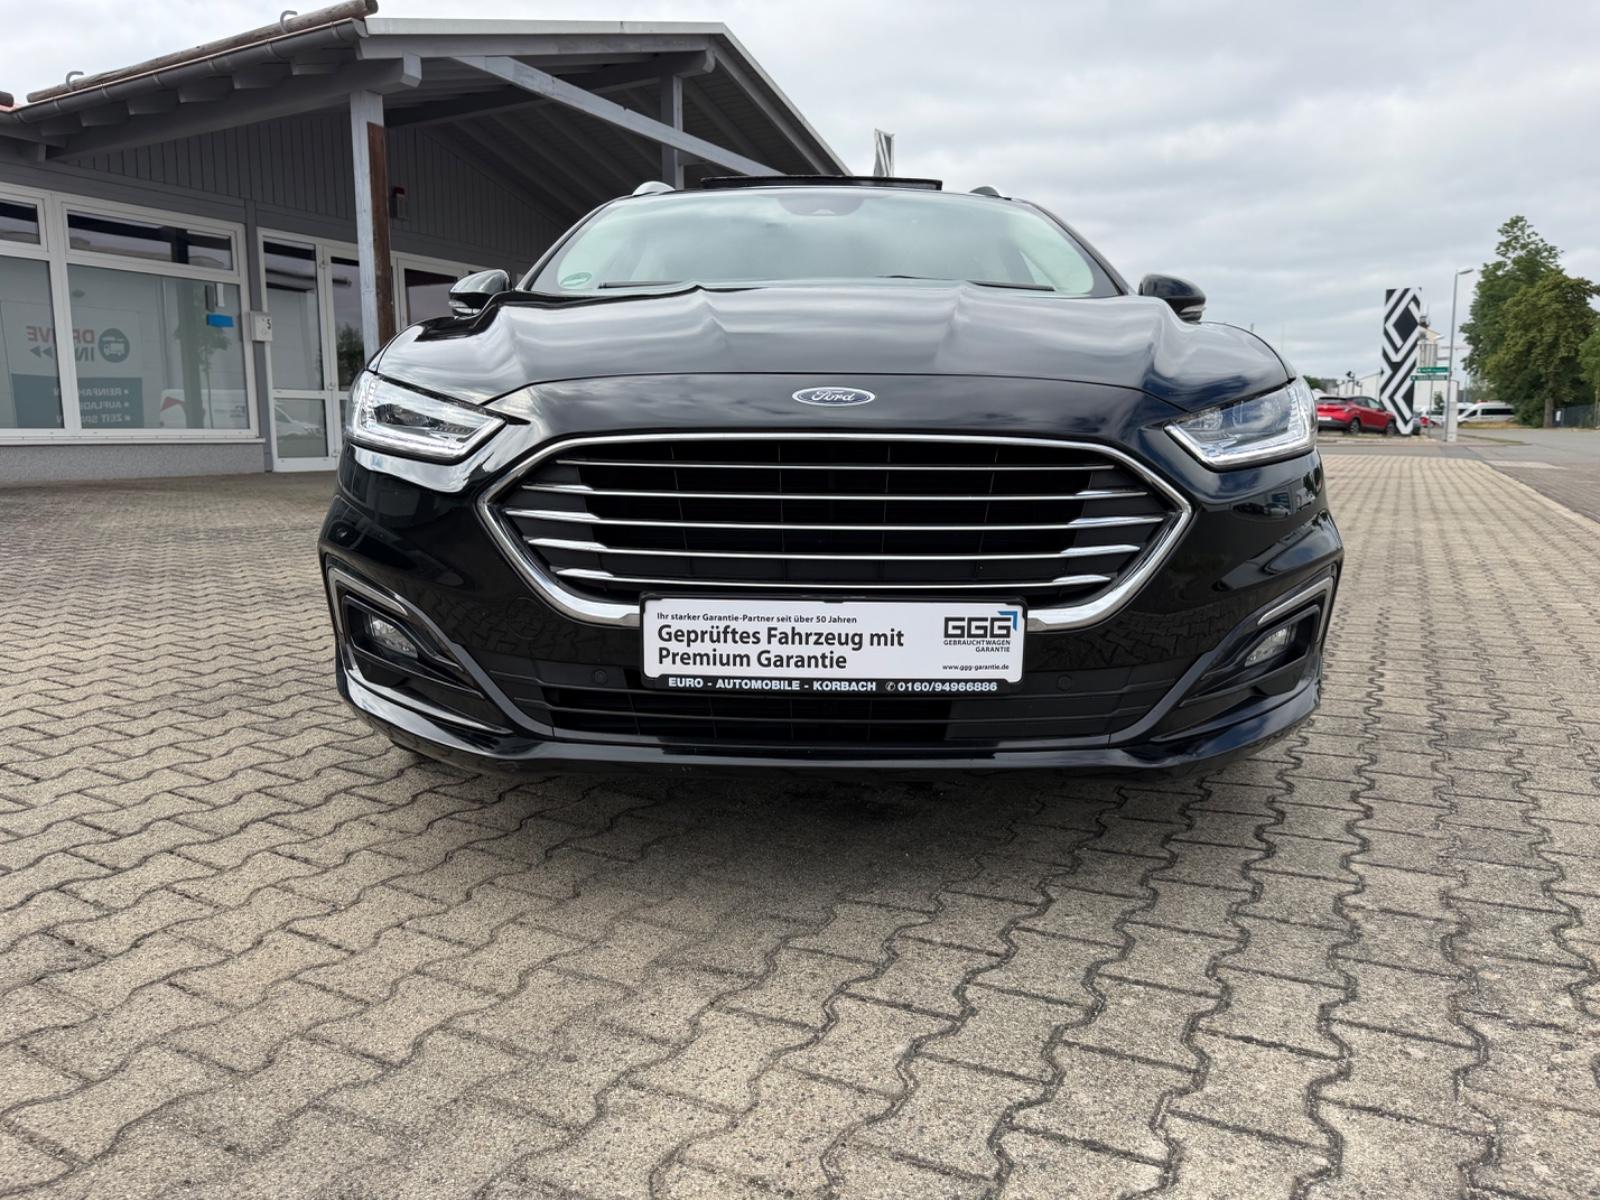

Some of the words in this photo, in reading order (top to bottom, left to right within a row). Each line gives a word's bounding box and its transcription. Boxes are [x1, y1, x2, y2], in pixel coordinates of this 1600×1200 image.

[657, 612, 669, 621] Ihr
[670, 613, 701, 622] starker
[702, 613, 775, 624] Garantie-Partner
[776, 615, 792, 623] seit
[793, 615, 814, 624] über
[815, 615, 827, 624] 50
[828, 615, 857, 624] Jahren
[944, 616, 1012, 639] GGG
[657, 624, 761, 648] Geprüftes
[767, 626, 864, 651] Fahrzeug
[869, 628, 904, 647] mit
[943, 639, 1011, 647] GEBRAUCHTWAGEN
[658, 647, 751, 668] Premium
[757, 650, 847, 669] Garantie
[942, 663, 1010, 672] www.ggg-garantie.de
[668, 677, 704, 688] EURO
[716, 678, 800, 691] AUTOMOBILE
[813, 681, 876, 692] KORBACH
[897, 681, 998, 692] 0160/94966886
